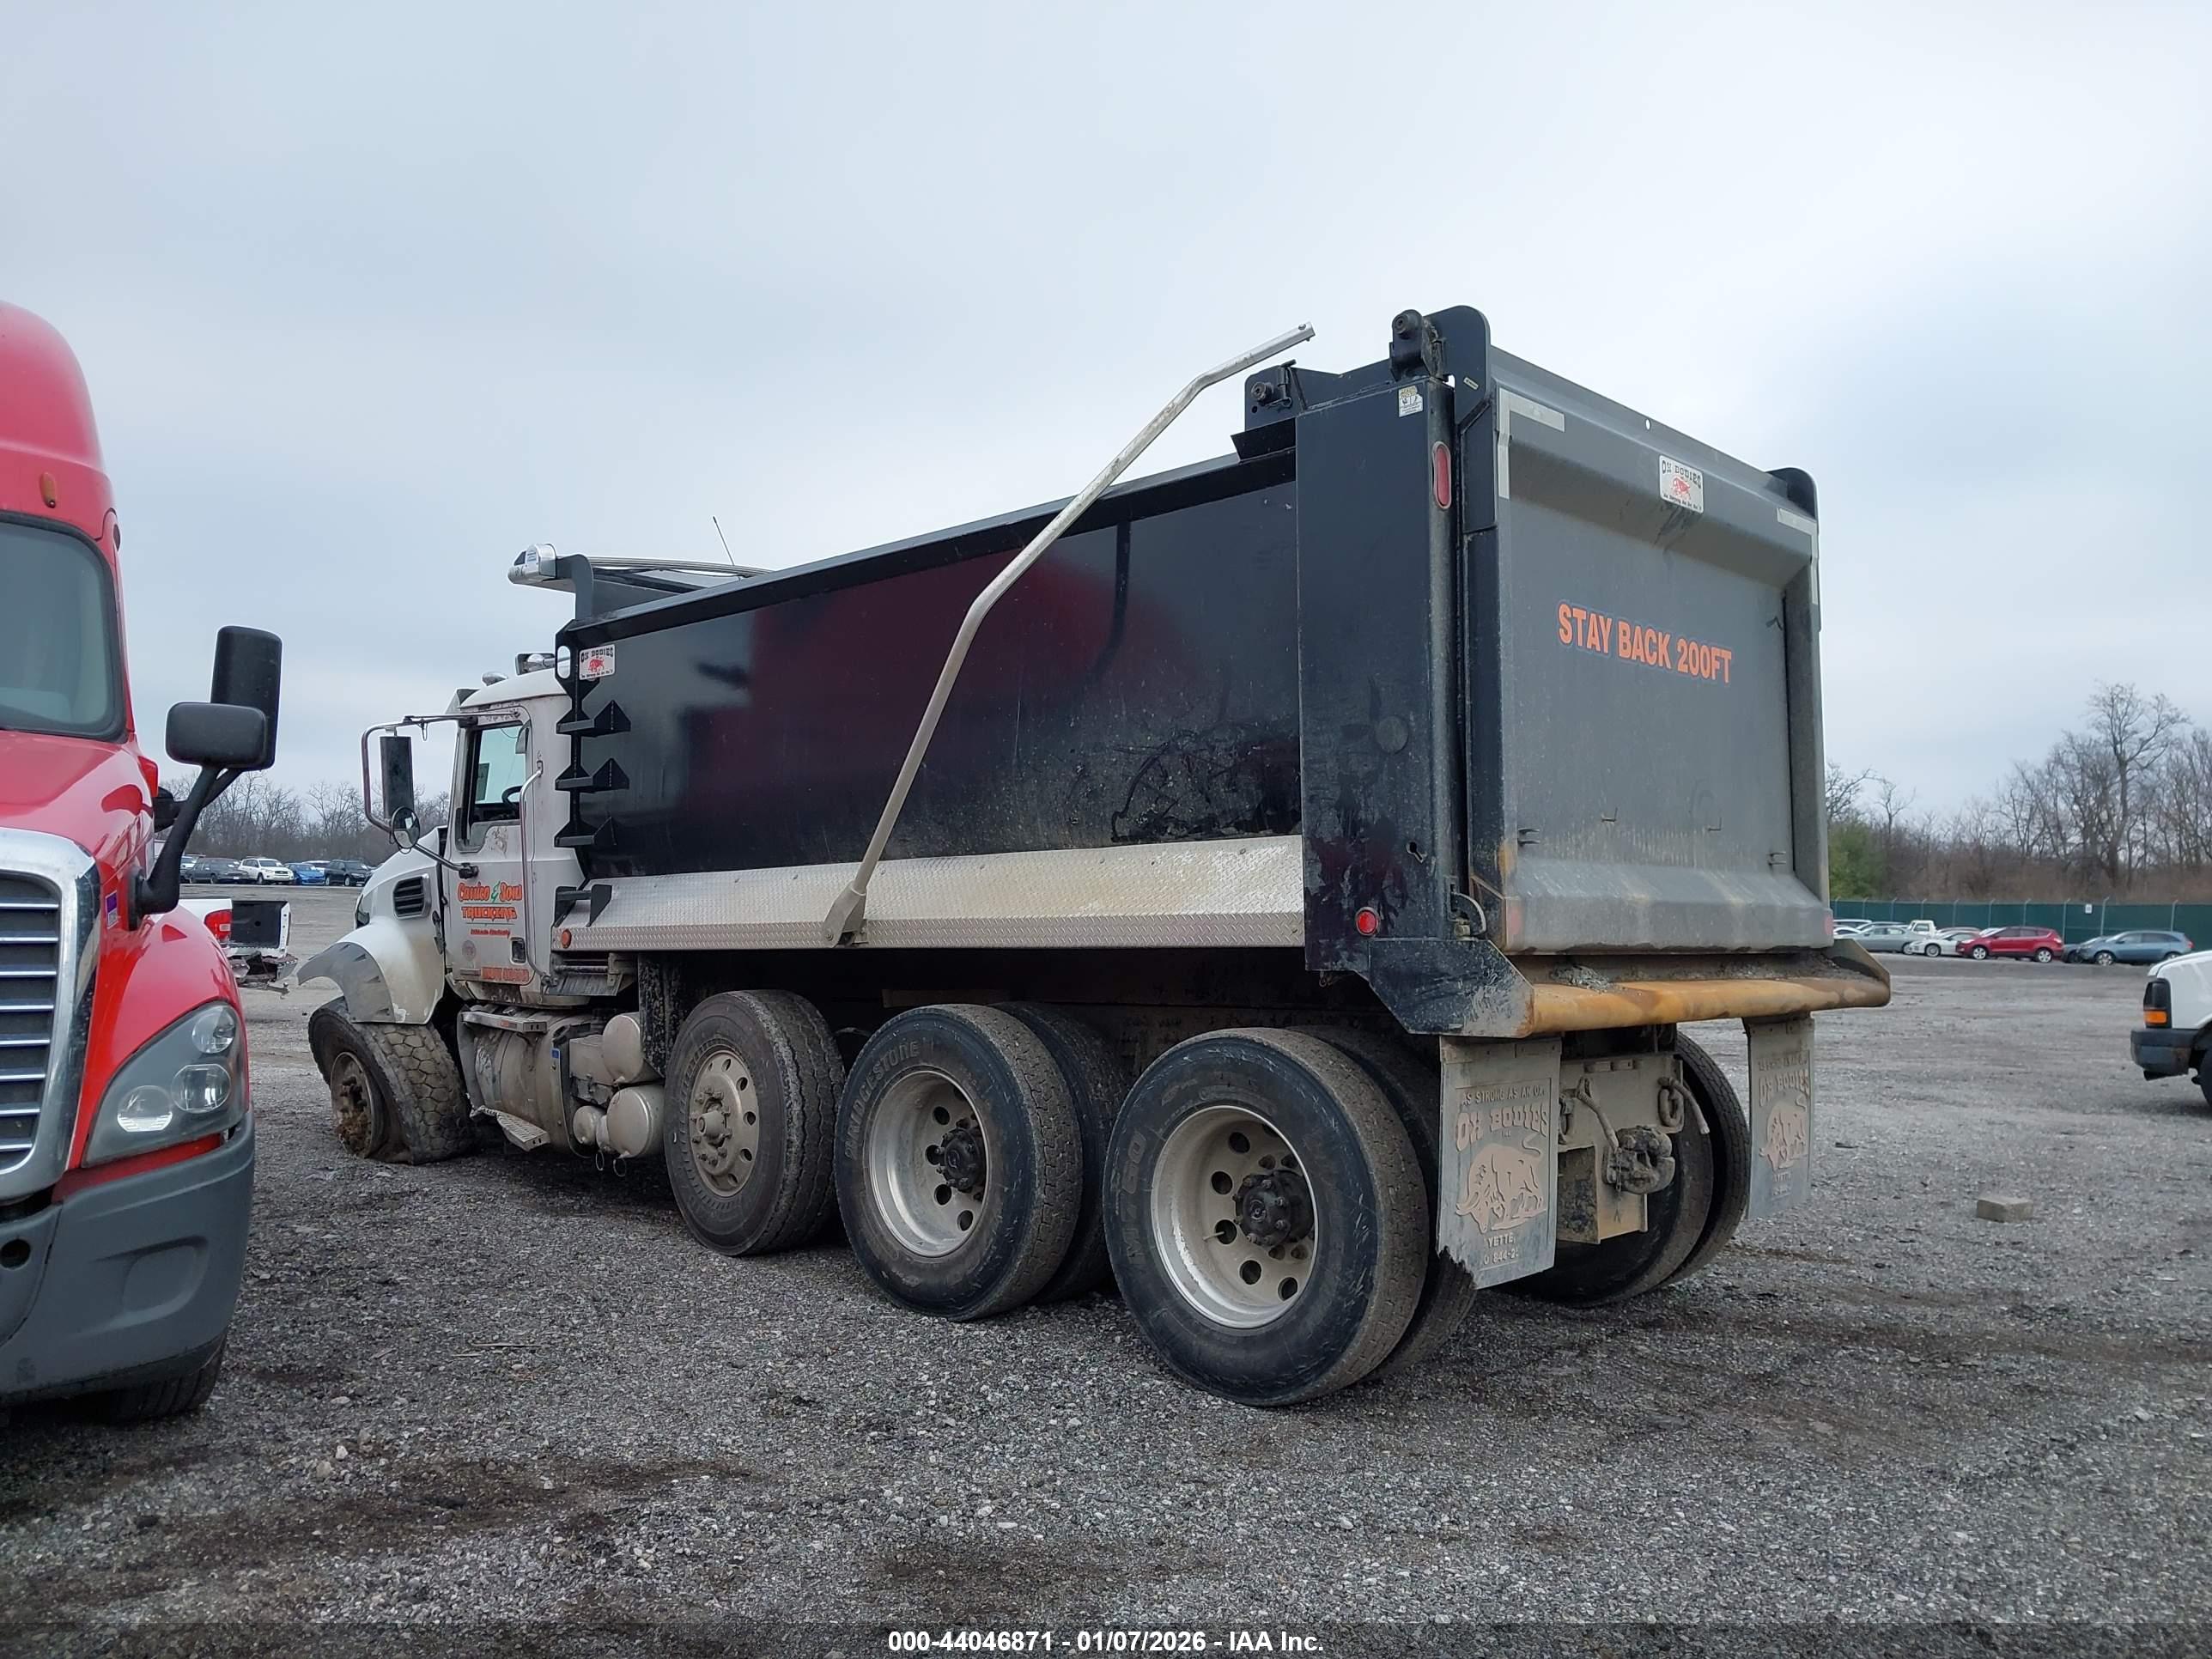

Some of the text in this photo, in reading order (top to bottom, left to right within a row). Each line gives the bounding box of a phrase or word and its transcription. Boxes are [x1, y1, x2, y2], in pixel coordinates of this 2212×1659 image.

[1558, 603, 1732, 684] STAY BACK 200FT
[491, 881, 500, 903] &
[460, 906, 518, 921] TRUCKING
[1476, 1089, 1504, 1104] STRONG
[1507, 1085, 1518, 1099] AS
[1455, 1102, 1549, 1152] OX BODIES
